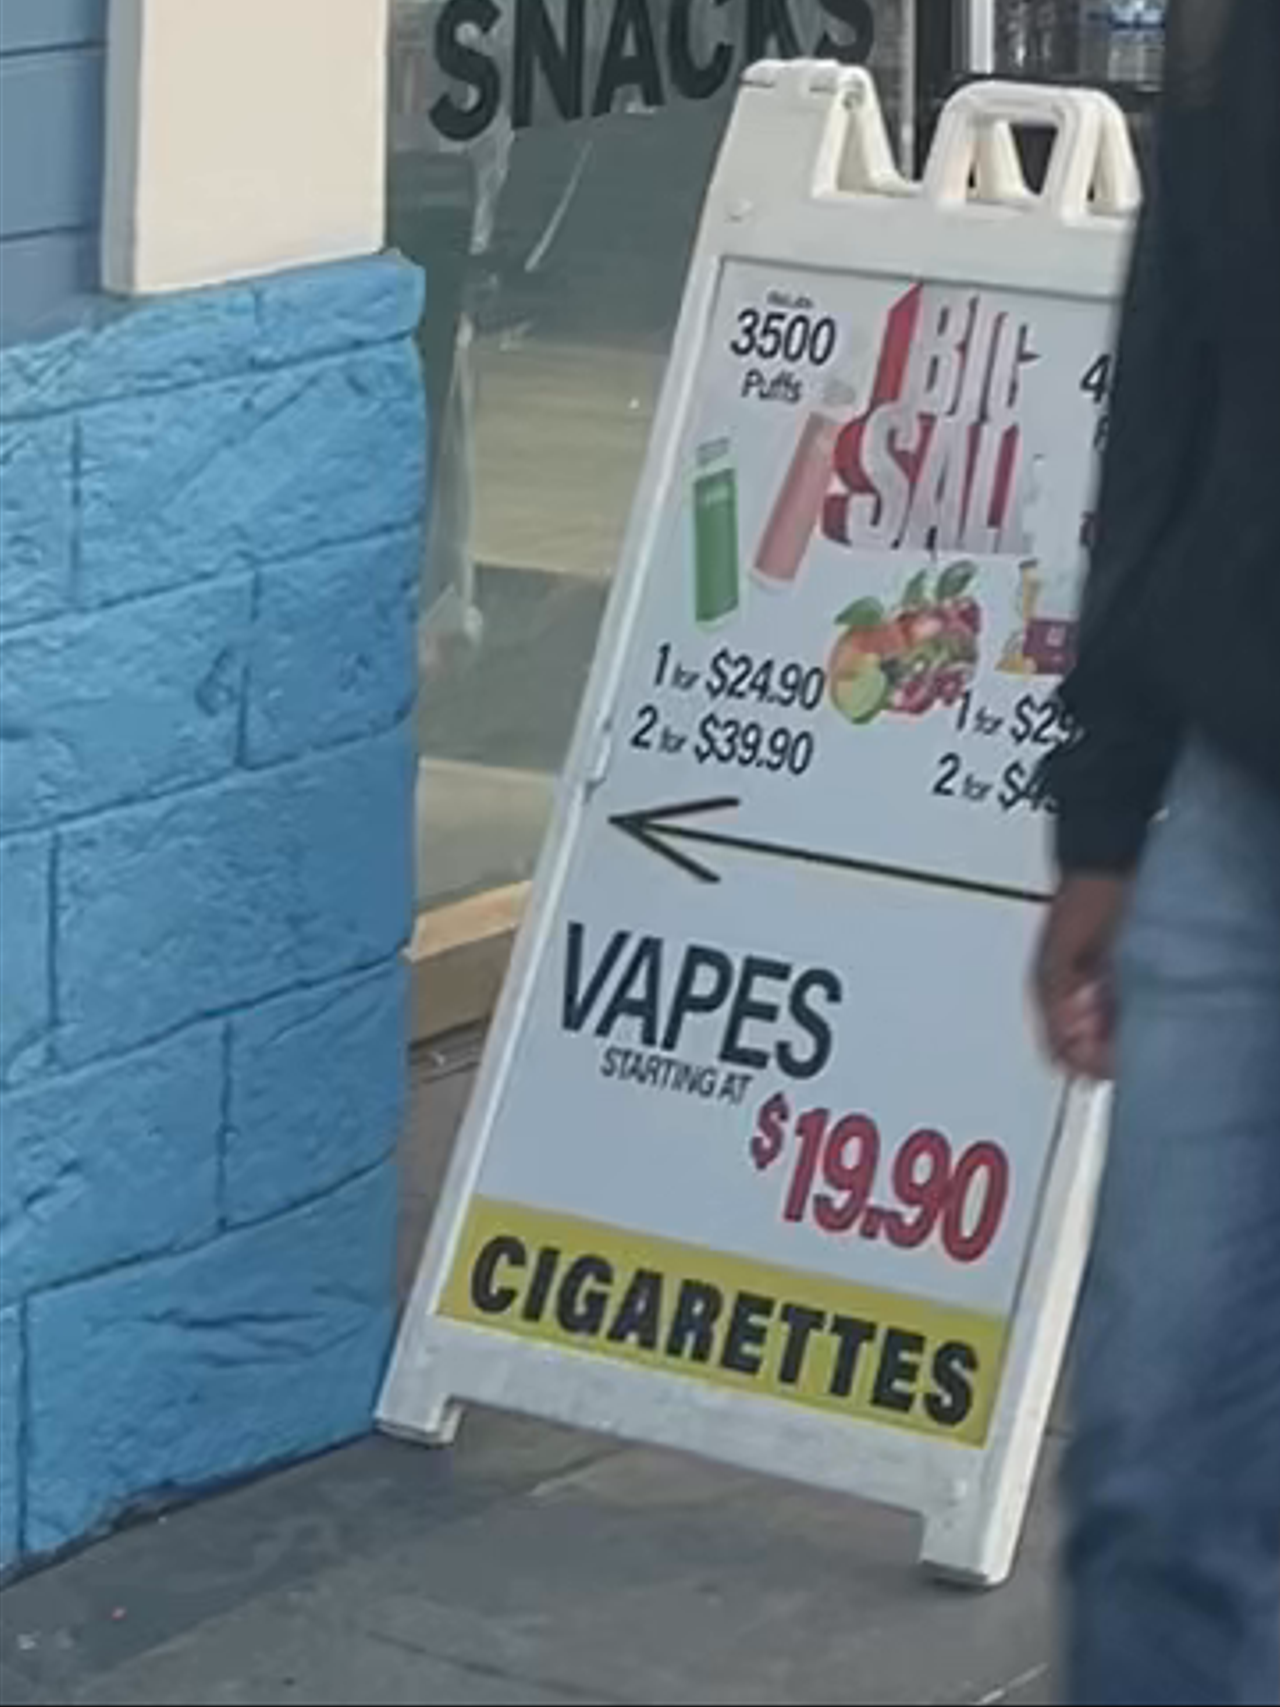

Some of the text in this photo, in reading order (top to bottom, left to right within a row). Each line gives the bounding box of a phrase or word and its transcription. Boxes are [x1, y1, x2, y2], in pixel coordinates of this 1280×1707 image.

[730, 307, 836, 366] 3500
[740, 368, 803, 405] Puffs
[652, 644, 826, 710] 1 for $24.90
[630, 706, 815, 775] 2 for $39.90
[956, 690, 972, 730] 1
[932, 753, 961, 796] 2
[560, 922, 843, 1079] VAPES
[600, 1046, 754, 1106] STARTING AT
[749, 1091, 1009, 1263] $19.90
[469, 1235, 979, 1426] CIGARETTES
